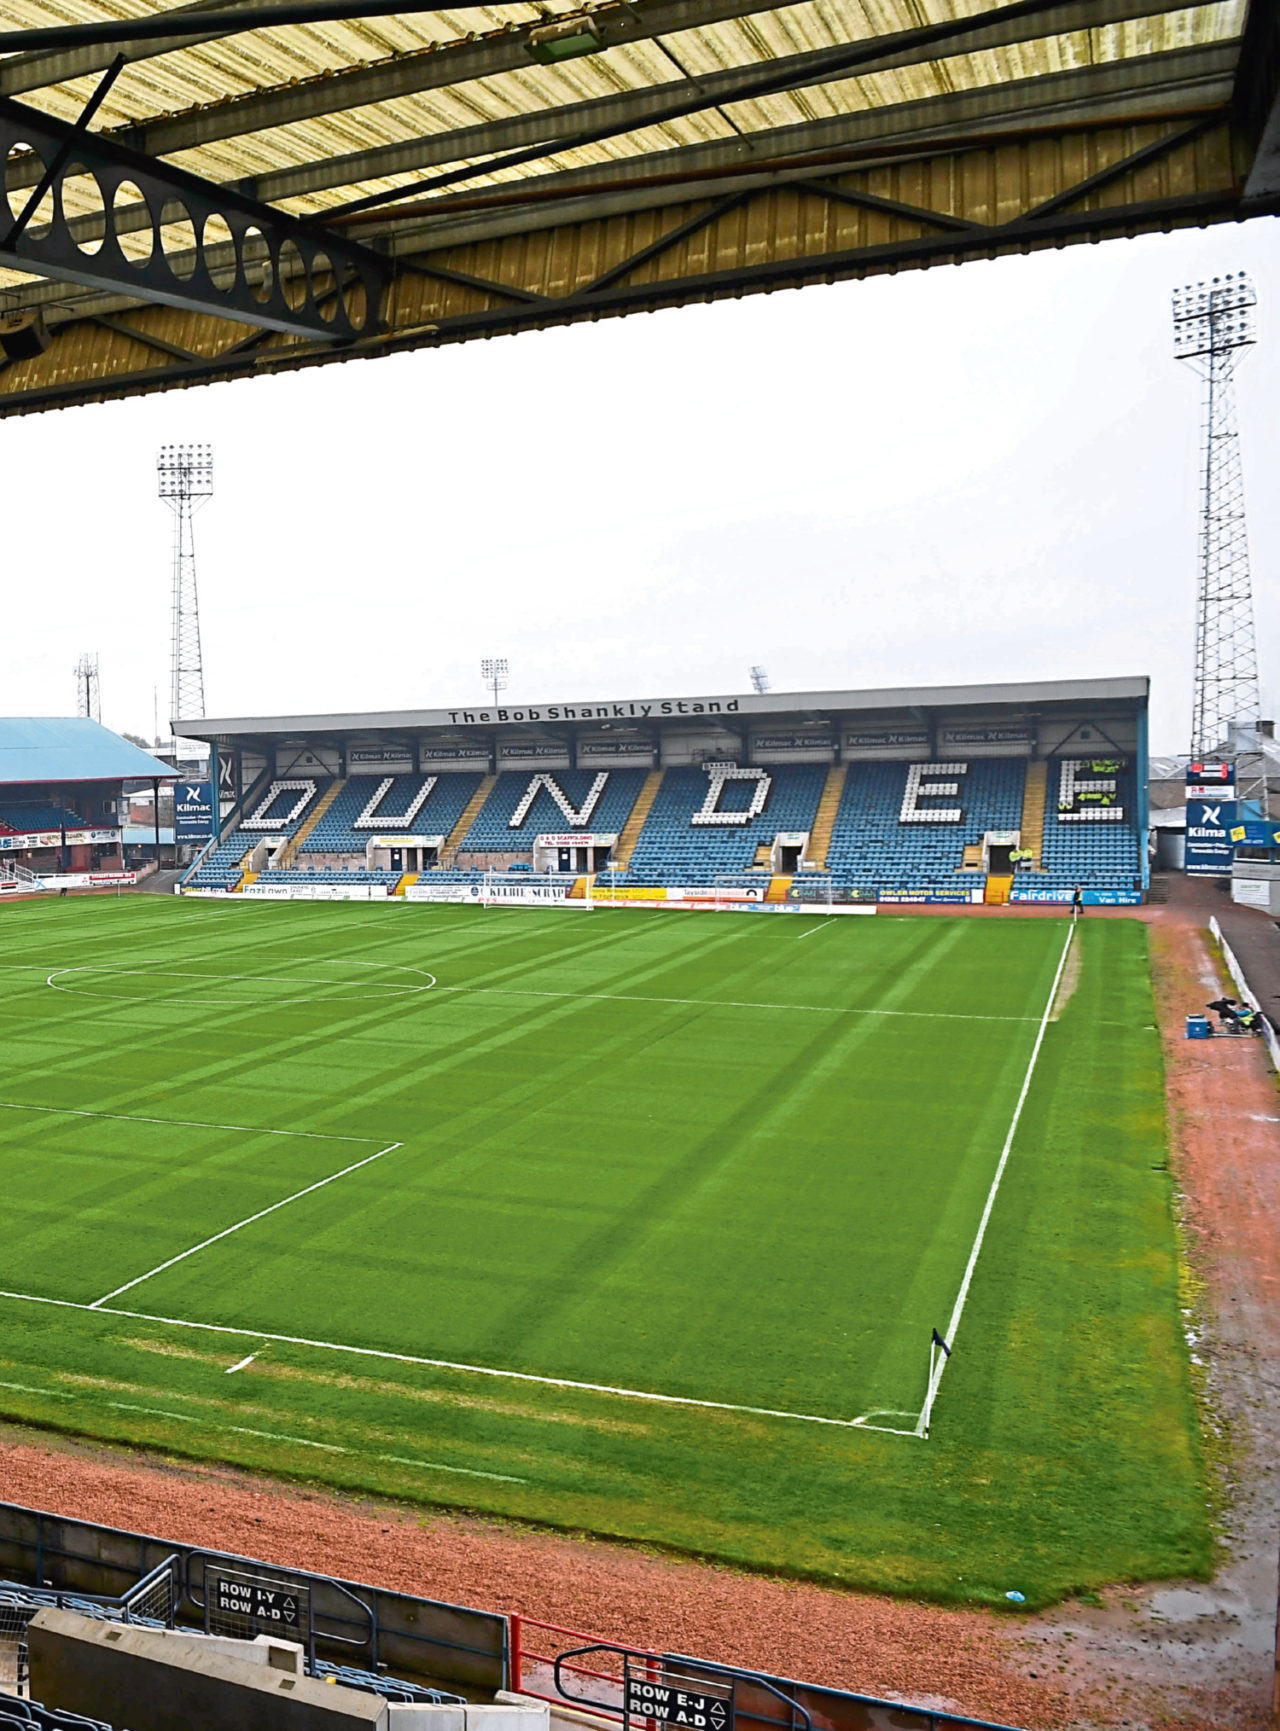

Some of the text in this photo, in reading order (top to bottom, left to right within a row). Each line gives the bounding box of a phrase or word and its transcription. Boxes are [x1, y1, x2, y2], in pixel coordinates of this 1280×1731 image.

[448, 700, 739, 723] The Bob Shankly Stand
[177, 804, 211, 812] Kilmac
[1188, 827, 1226, 838] Kilma
[1010, 891, 1072, 901] Fairdrive
[220, 1582, 275, 1604] ROW I-Y
[220, 1597, 281, 1620] ROW A-D
[630, 1682, 705, 1710] ROW E-J
[629, 1699, 706, 1727] ROW A-D
